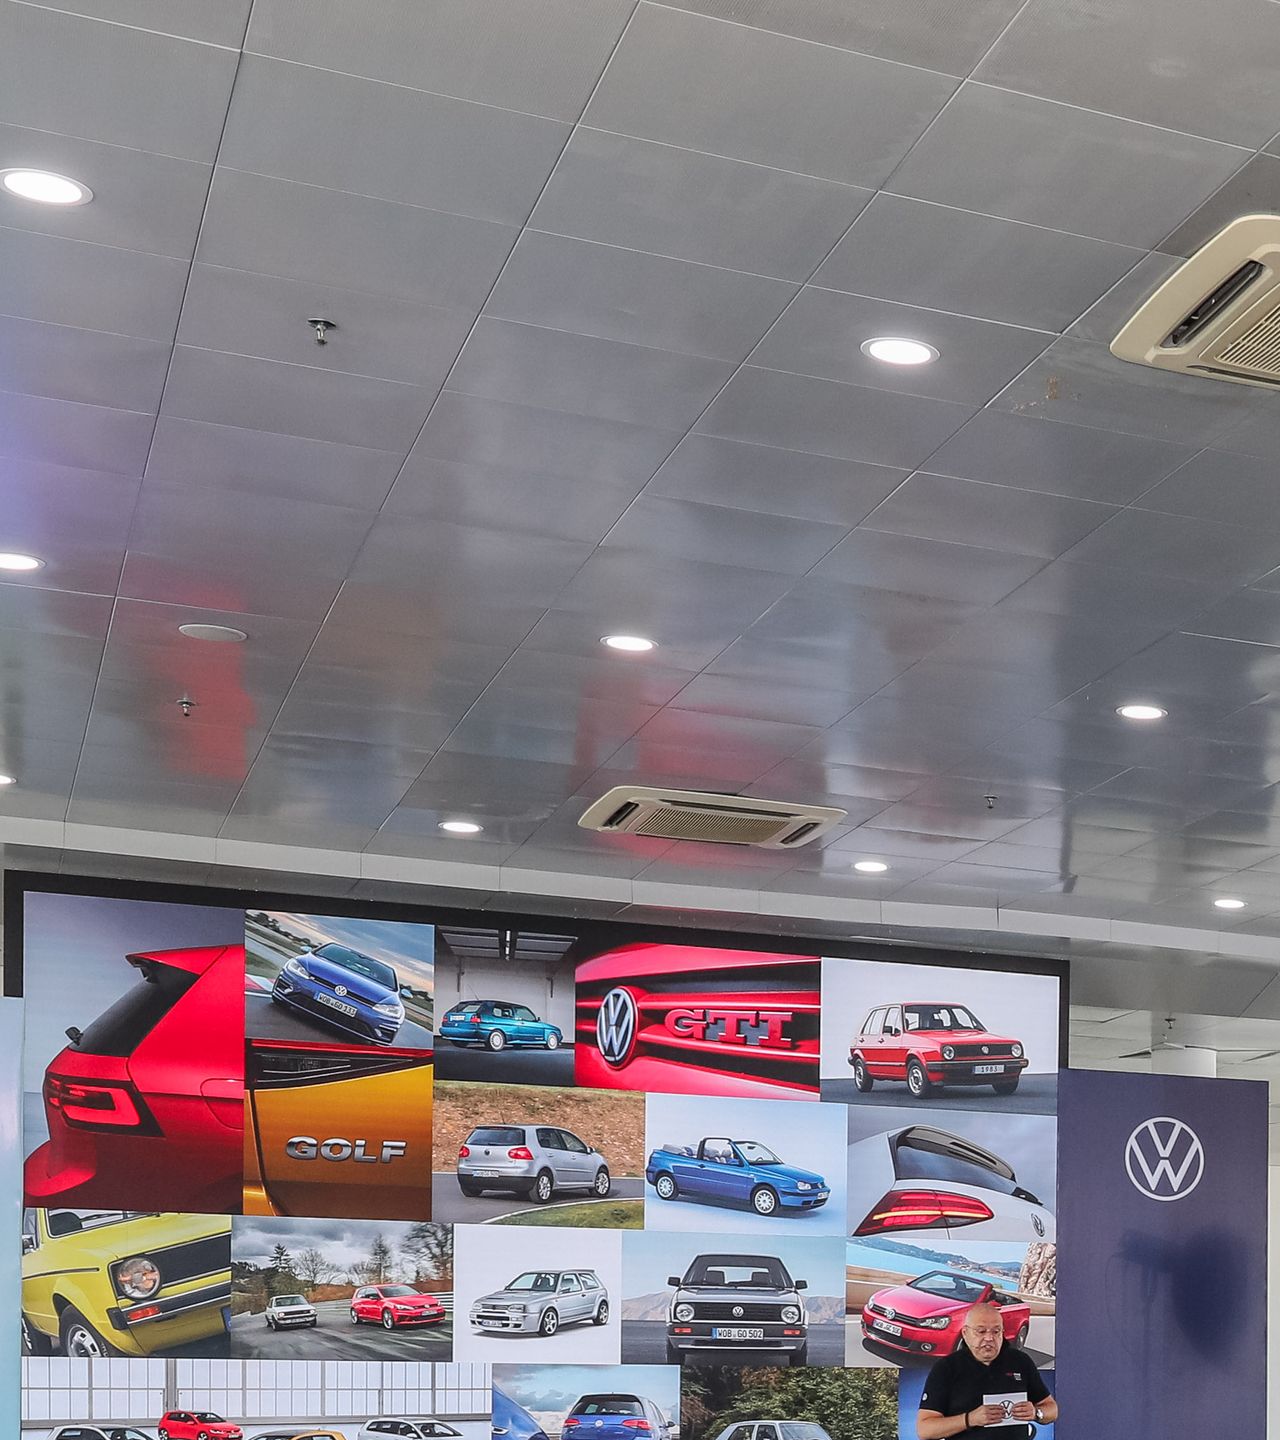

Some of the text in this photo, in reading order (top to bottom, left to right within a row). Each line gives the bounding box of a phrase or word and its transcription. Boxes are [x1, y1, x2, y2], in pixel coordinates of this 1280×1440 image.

[664, 1008, 793, 1048] GTI
[286, 1135, 407, 1163] GOLF
[748, 1330, 762, 1338] 502
